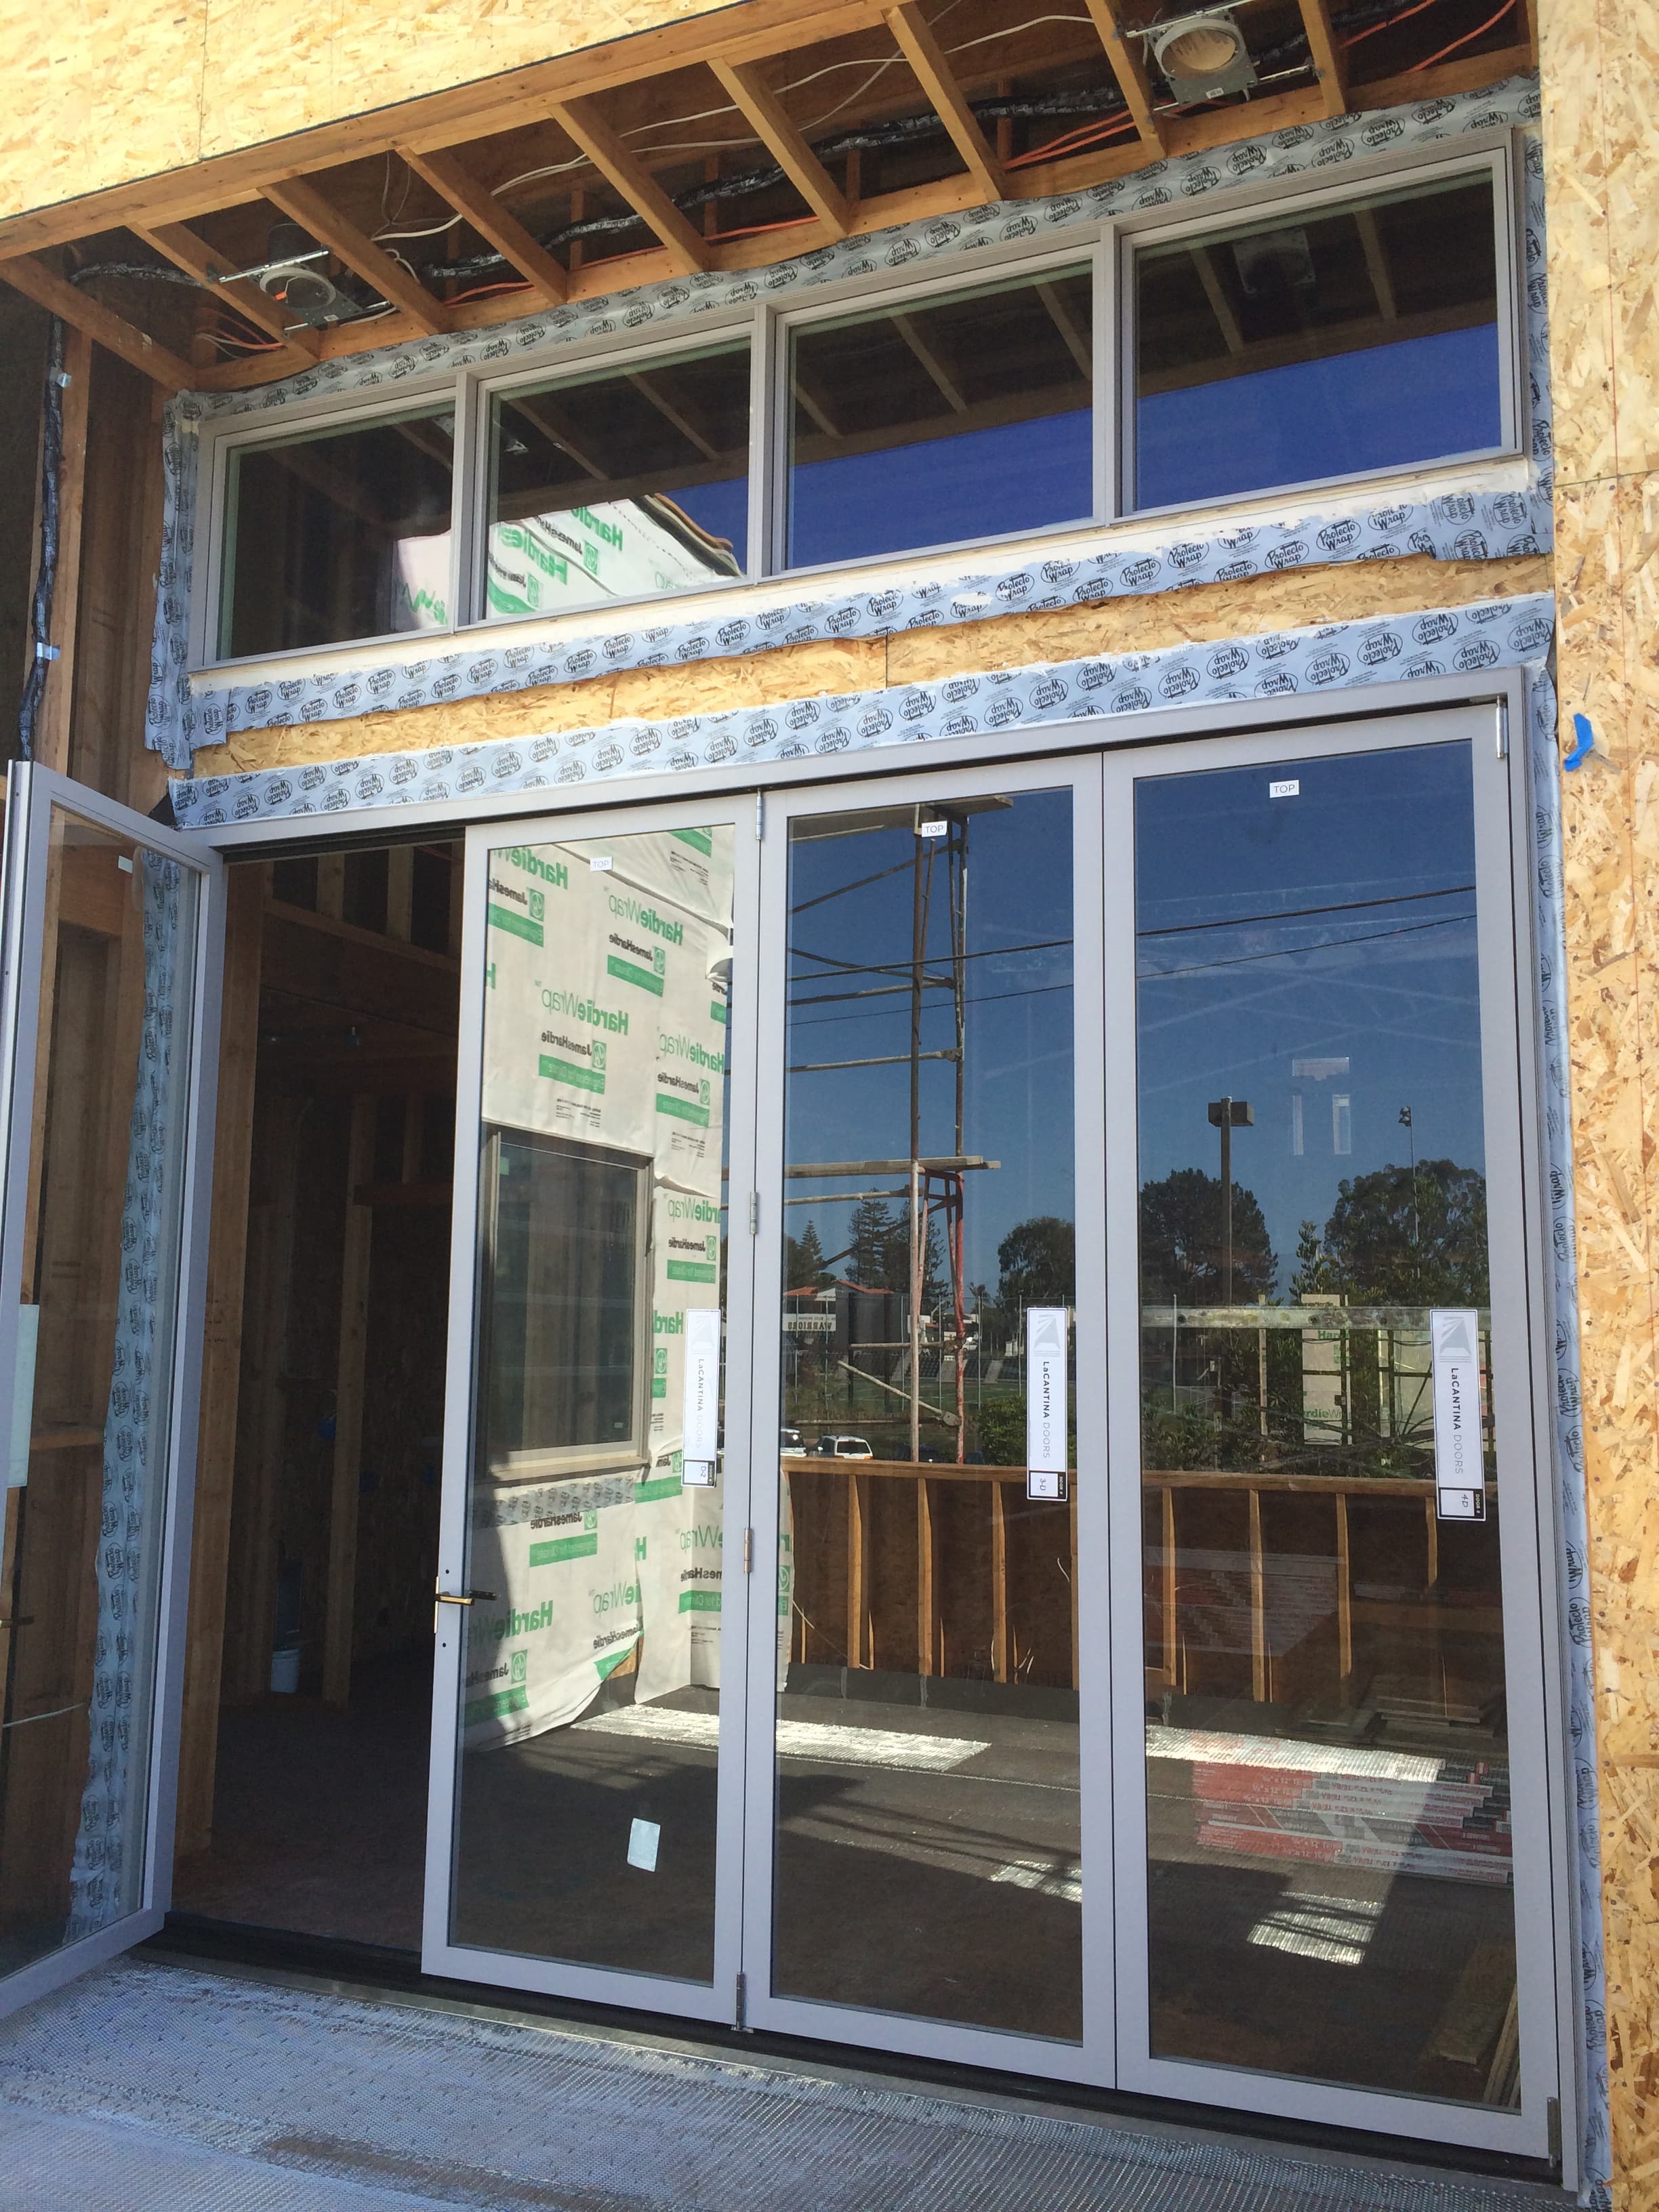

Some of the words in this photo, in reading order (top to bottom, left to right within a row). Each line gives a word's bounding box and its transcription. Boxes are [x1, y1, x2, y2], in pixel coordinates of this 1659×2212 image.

[1367, 120, 1405, 147] Protecto
[1368, 119, 1393, 134] Wrap
[1233, 146, 1256, 162] Wrap
[1233, 149, 1267, 176] Protecto
[1186, 170, 1219, 196] Protecto
[1187, 167, 1210, 183] Wrap
[1049, 199, 1081, 222] Protecto
[1051, 197, 1073, 211] Wrap
[930, 222, 949, 234] Wrap
[930, 223, 960, 247] Protecto
[1319, 520, 1355, 541] Protecto
[1326, 533, 1353, 550] Wrap
[1267, 541, 1303, 562] Protecto
[1122, 558, 1156, 581] Protecto
[1275, 553, 1301, 569] Wrap
[1129, 571, 1153, 586] Wrap
[1075, 578, 1109, 599] Protecto
[1082, 589, 1105, 602] Wrap
[869, 589, 900, 611] Protecto
[875, 600, 897, 616] Wrap
[827, 607, 857, 628] Protecto
[832, 619, 854, 633] Wrap
[1420, 614, 1450, 630] Wrap
[717, 620, 747, 640] Protecto
[1418, 619, 1458, 644] Protecto
[1516, 619, 1544, 636] Wrap
[603, 634, 632, 653] Protecto
[678, 638, 706, 656] Protecto
[722, 632, 743, 646] Wrap
[1365, 634, 1394, 651] Wrap
[1514, 626, 1552, 651] Protecto
[506, 646, 531, 663] Protecto
[609, 644, 629, 657] Wrap
[682, 648, 703, 660] Wrap
[1214, 649, 1242, 664] Wrap
[1364, 640, 1401, 665] Protecto
[1458, 644, 1499, 670] Protecto
[1461, 640, 1490, 657] Wrap
[510, 654, 529, 668] Wrap
[566, 649, 593, 668] Protecto
[570, 660, 590, 673] Wrap
[1212, 655, 1248, 679] Protecto
[1313, 654, 1342, 671] Wrap
[469, 659, 495, 678] Protecto
[474, 669, 492, 683] Wrap
[1165, 668, 1193, 684] Wrap
[1311, 660, 1349, 685] Protecto
[367, 669, 392, 689] Protecto
[372, 680, 390, 694] Wrap
[433, 674, 459, 693] Protecto
[1037, 679, 1062, 696] Wrap
[1164, 674, 1198, 698] Protecto
[334, 683, 358, 702] Protecto
[337, 691, 356, 708] Wrap
[437, 684, 456, 698] Wrap
[1034, 687, 1067, 709] Protecto
[247, 691, 270, 709] Protecto
[250, 700, 268, 713] Wrap
[300, 699, 325, 718] Protecto
[903, 697, 935, 720] Protecto
[905, 692, 930, 708] Wrap
[991, 698, 1016, 714] Wrap
[305, 708, 322, 721] Wrap
[791, 701, 815, 718] Wrap
[863, 710, 887, 724] Wrap
[989, 705, 1021, 727] Protecto
[205, 707, 213, 735] Protecto
[213, 709, 222, 732] Wrap
[750, 719, 771, 735] Wrap
[788, 707, 819, 730] Protecto
[861, 716, 891, 738] Protecto
[635, 729, 656, 743] Wrap
[712, 736, 733, 751] Wrap
[747, 724, 777, 747] Protecto
[598, 744, 618, 760] Wrap
[632, 735, 661, 756] Protecto
[707, 741, 737, 763] Protecto
[394, 759, 413, 773] Wrap
[494, 757, 521, 778] Protecto
[497, 752, 516, 766] Wrap
[595, 750, 623, 771] Protecto
[392, 765, 417, 785] Protecto
[267, 785, 291, 805] Protecto
[270, 780, 287, 794] Wrap
[1274, 784, 1295, 794] TOP
[925, 824, 944, 834] TOP
[593, 860, 609, 869] TOP
[697, 1359, 705, 1411] LaCANTINA
[1451, 1368, 1461, 1430] LaCANTINA
[1454, 1435, 1463, 1474] DOORS
[1460, 1494, 1469, 1508] 4D
[1569, 1603, 1584, 1645] Protecto
